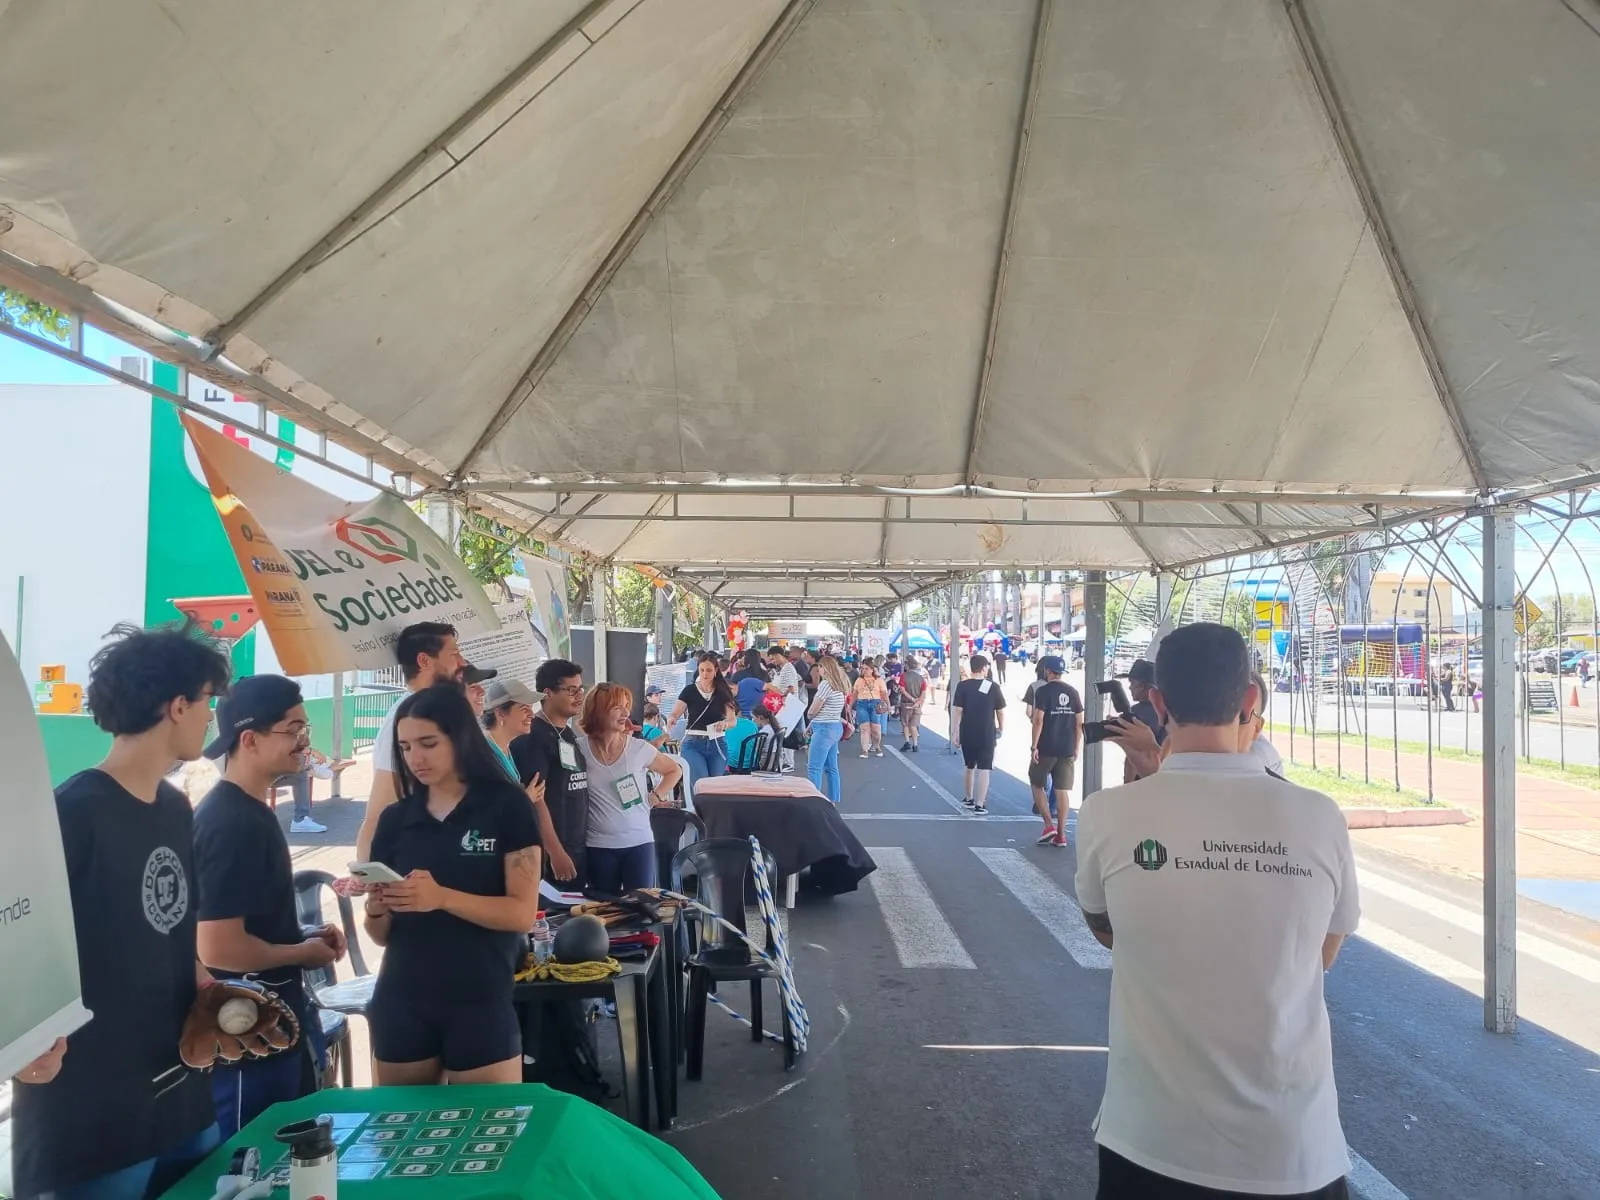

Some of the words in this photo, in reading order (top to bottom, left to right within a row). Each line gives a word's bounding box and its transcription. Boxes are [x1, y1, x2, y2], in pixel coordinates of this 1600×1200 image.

[313, 567, 463, 632] Sociedade
[477, 838, 497, 852] PET
[0, 896, 31, 926] nde
